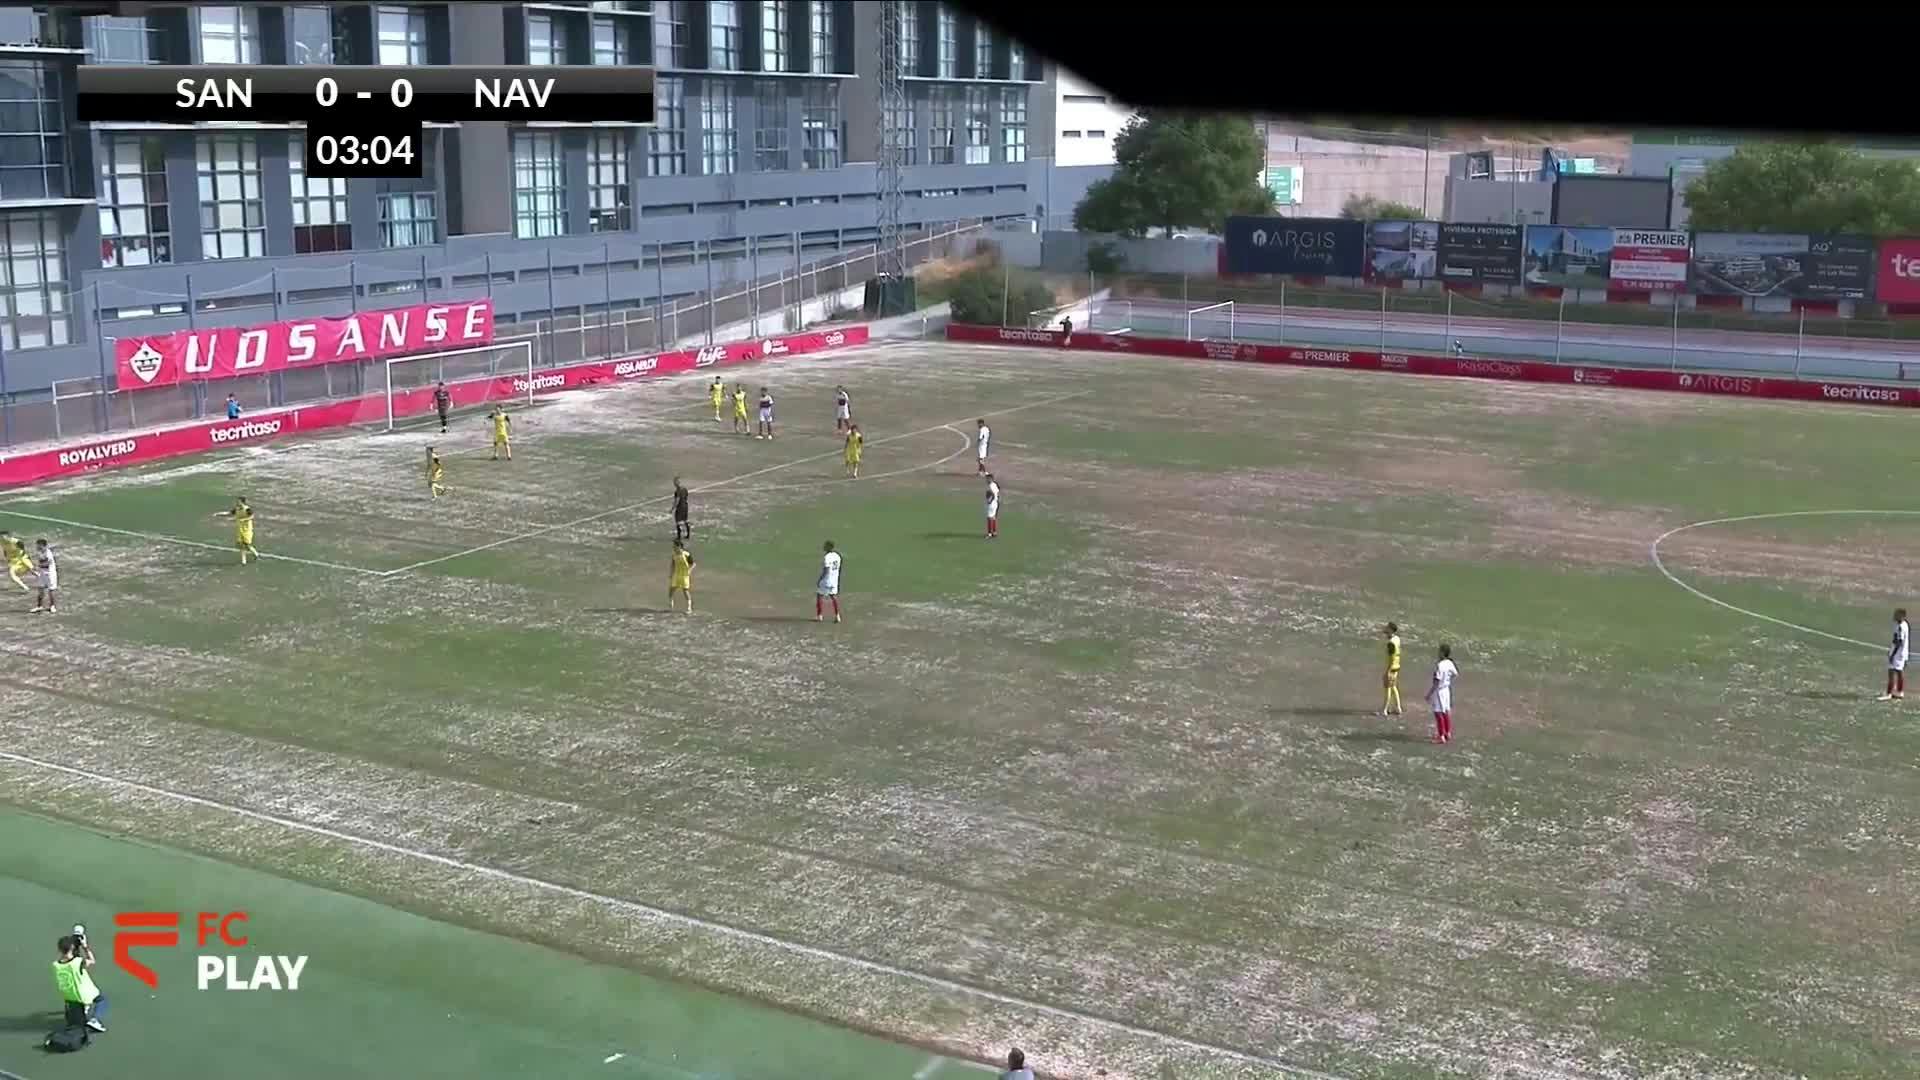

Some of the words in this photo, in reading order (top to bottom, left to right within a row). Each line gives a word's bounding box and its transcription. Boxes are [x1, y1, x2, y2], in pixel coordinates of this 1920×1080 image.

[1269, 230, 1336, 249] ARGIS
[1633, 232, 1686, 246] PREMIER
[1000, 327, 1053, 342] tecnitasa
[1304, 350, 1350, 363] PREMIER
[1693, 375, 1752, 393] ARGIS
[1822, 384, 1900, 401] tecnitasa
[209, 420, 281, 443] tecnitasa
[59, 439, 136, 466] ROYALVERD
